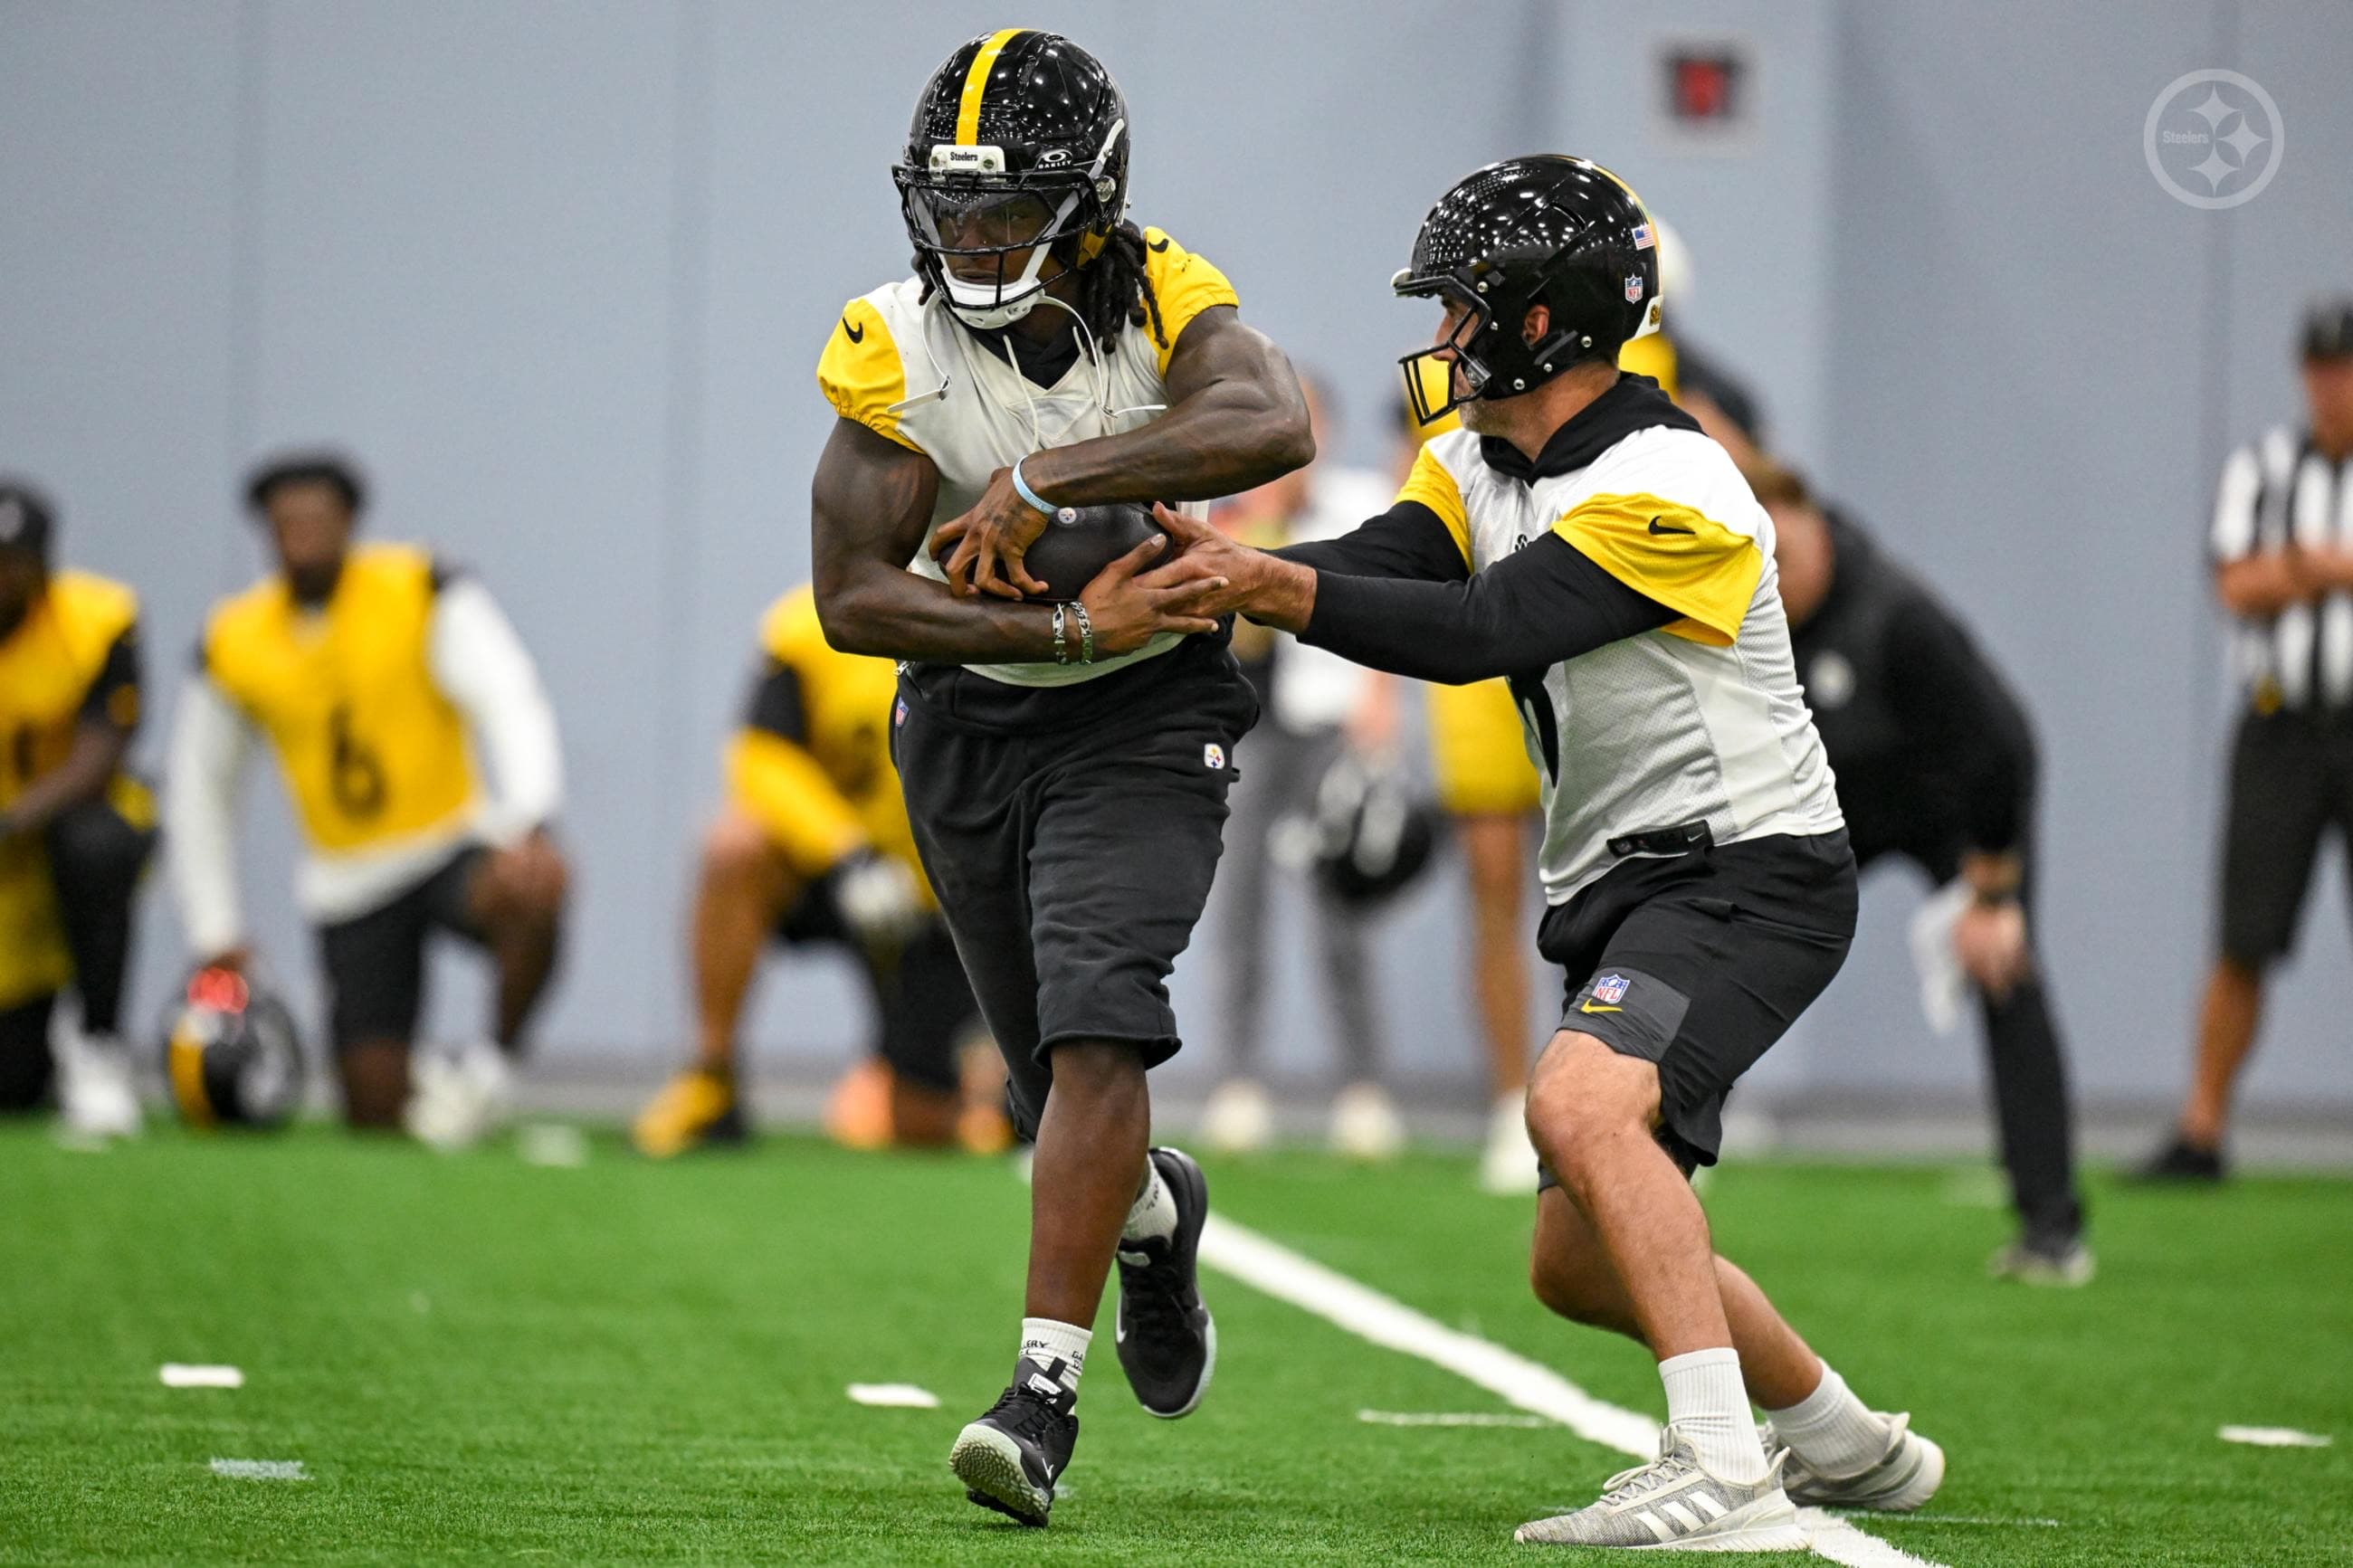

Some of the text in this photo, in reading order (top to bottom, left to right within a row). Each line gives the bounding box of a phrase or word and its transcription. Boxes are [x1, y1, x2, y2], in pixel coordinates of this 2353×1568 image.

[950, 151, 978, 161] Steelers
[1038, 159, 1072, 169] OAKLEY
[1595, 987, 1619, 1000] NFL
